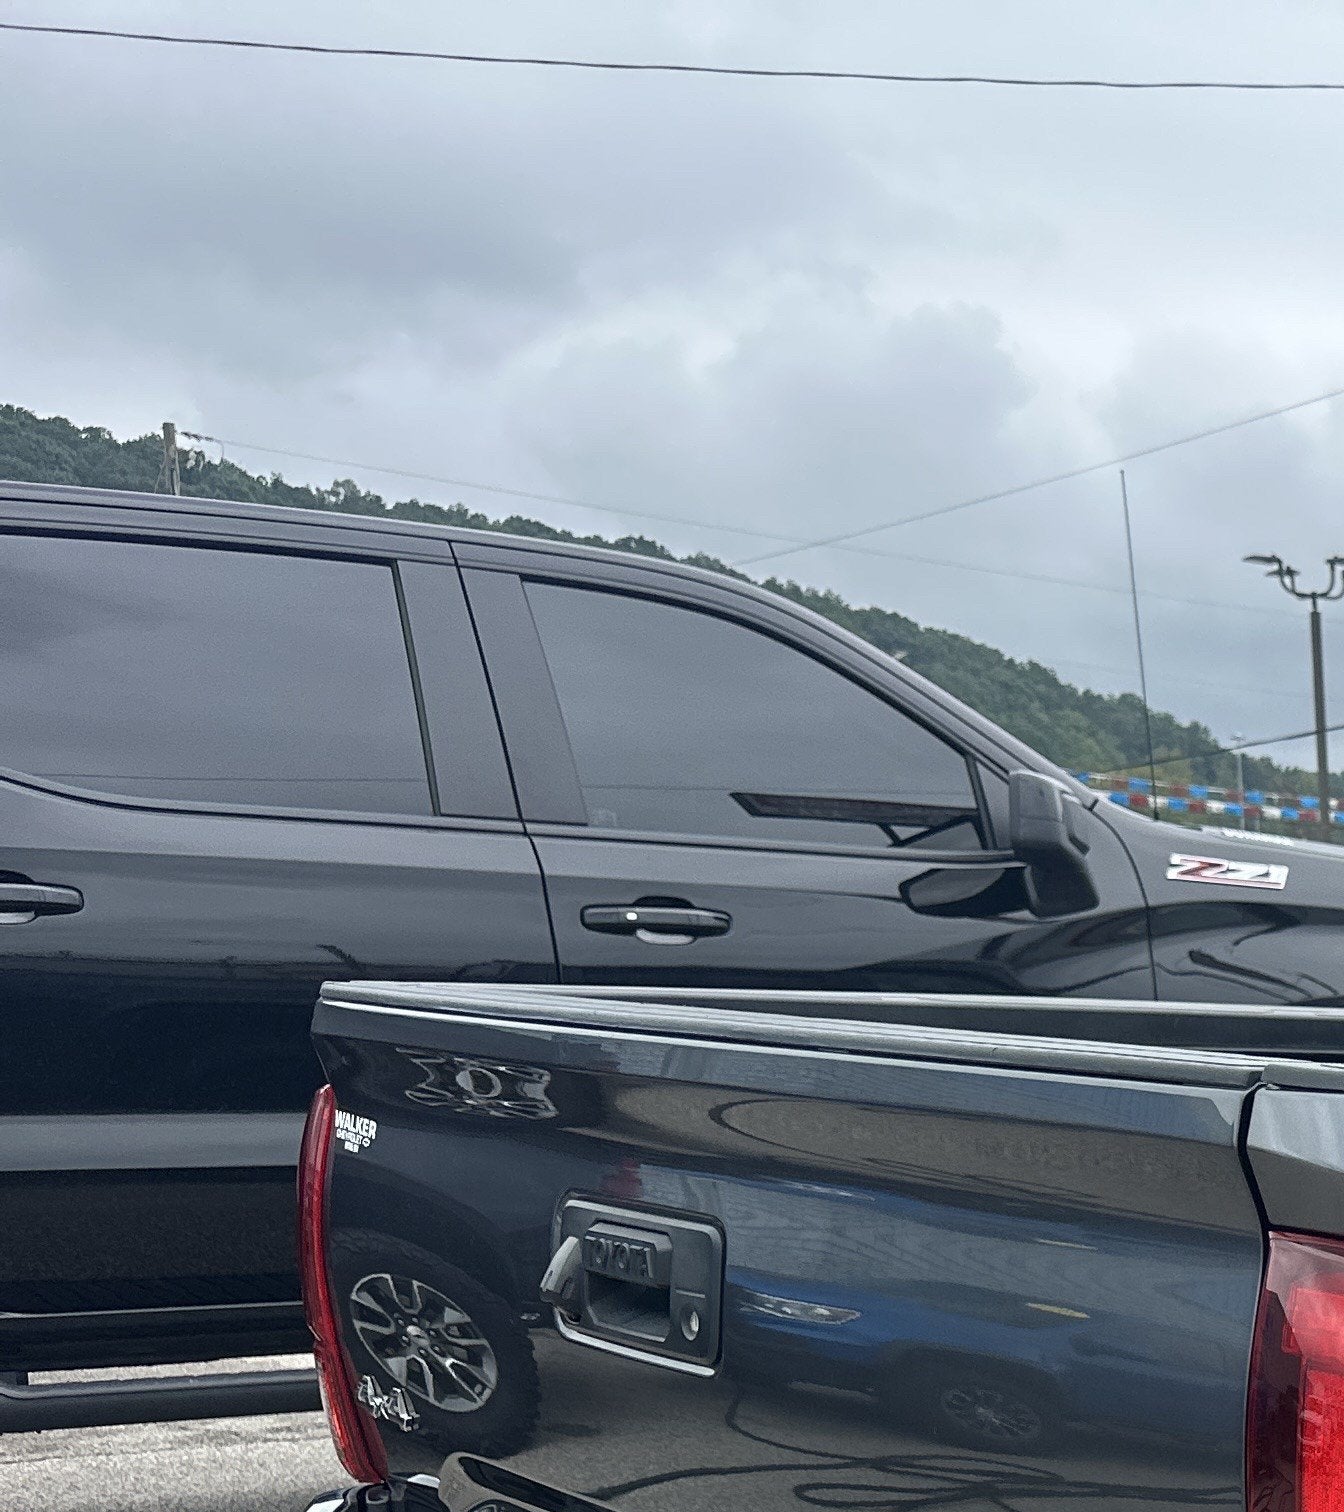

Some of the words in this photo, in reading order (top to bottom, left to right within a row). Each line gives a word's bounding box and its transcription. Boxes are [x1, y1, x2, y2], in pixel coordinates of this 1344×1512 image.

[1165, 852, 1290, 890] Z71
[334, 1109, 378, 1141] WALKER
[584, 1235, 655, 1280] TOYOTA
